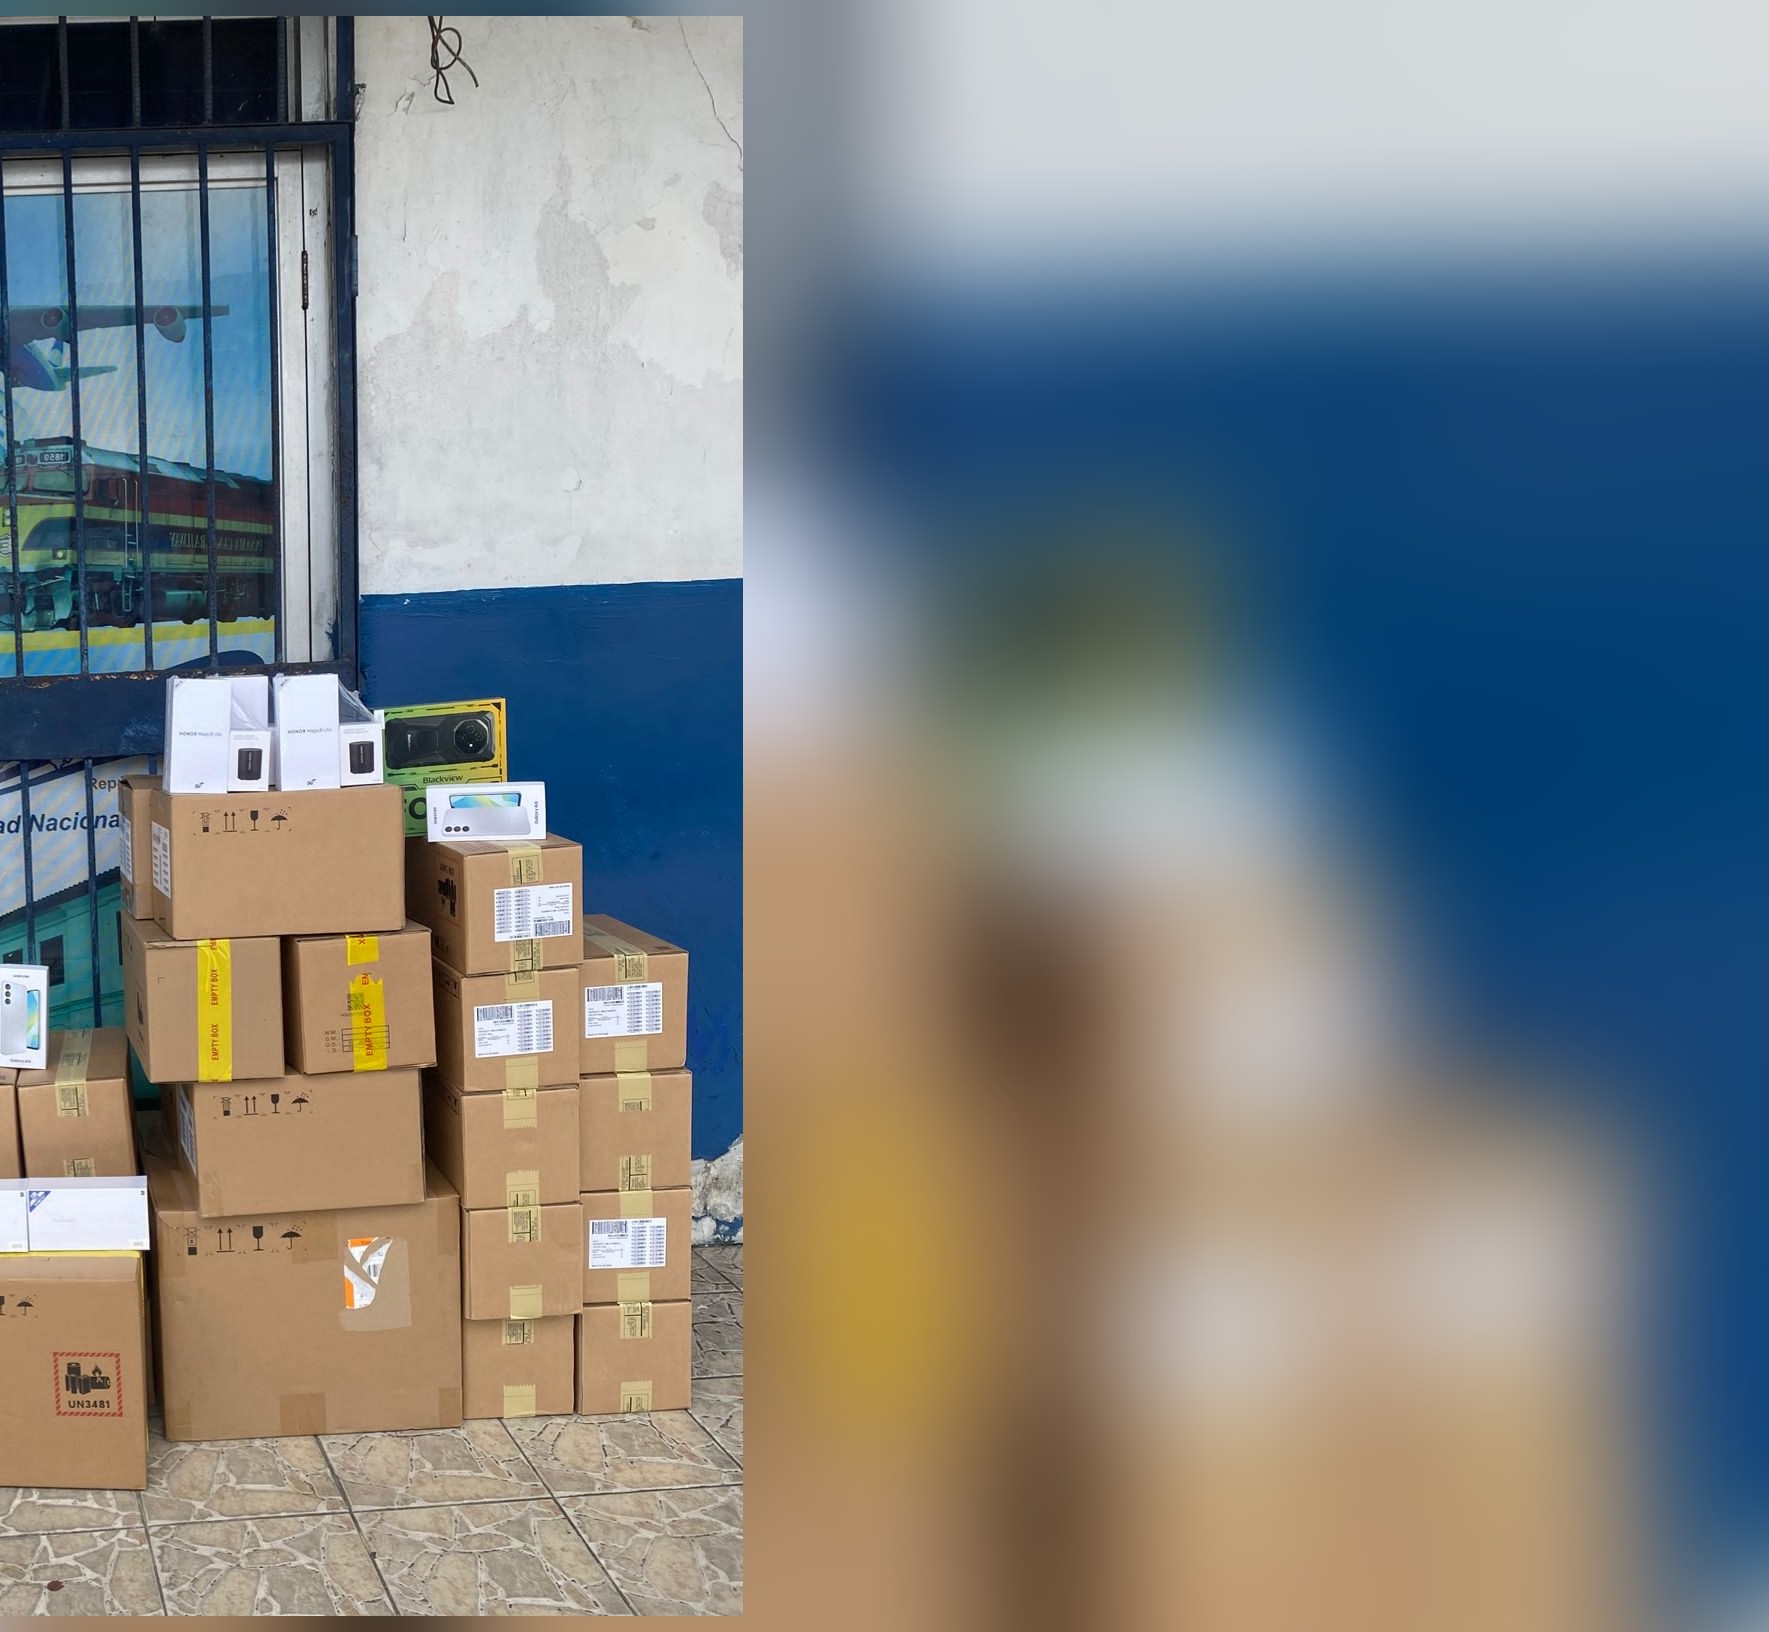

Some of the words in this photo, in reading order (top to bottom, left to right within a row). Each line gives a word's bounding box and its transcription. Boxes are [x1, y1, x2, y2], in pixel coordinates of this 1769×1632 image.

[92, 777, 119, 792] Rep
[423, 775, 463, 784] Blackview
[30, 812, 120, 833] Naciona
[211, 969, 219, 982] BOX
[211, 984, 219, 1006] EMPTY
[363, 1003, 372, 1024] BOX
[211, 1024, 219, 1038] BOX
[211, 1039, 219, 1061] EMPTY
[364, 1026, 374, 1056] EMPTY
[68, 1400, 110, 1408] UN3481
